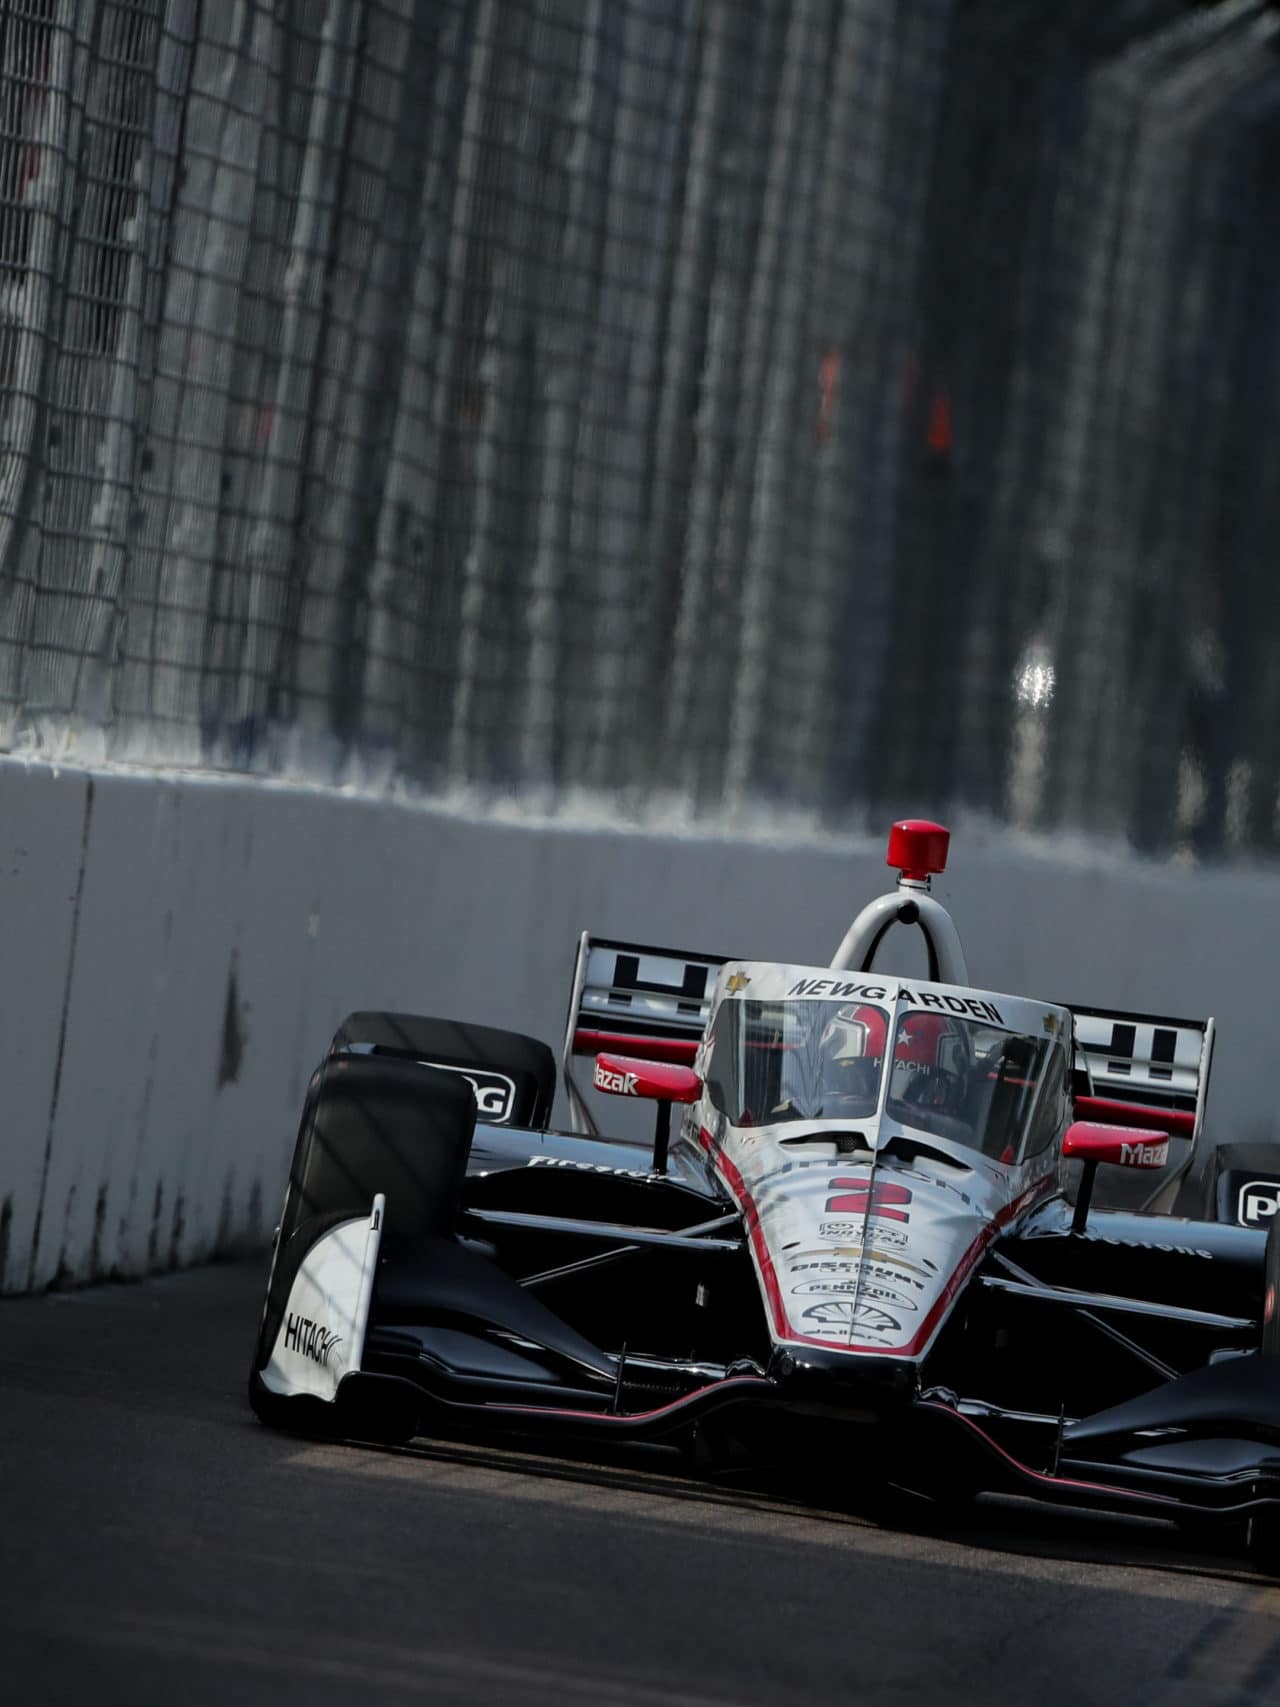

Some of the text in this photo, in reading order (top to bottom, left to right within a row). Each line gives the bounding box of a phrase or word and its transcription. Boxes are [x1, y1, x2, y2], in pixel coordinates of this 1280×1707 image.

[787, 978, 1005, 1025] NEWGARDEN
[594, 1063, 639, 1097] azak
[824, 1177, 913, 1224] 2
[790, 1262, 925, 1291] DISCOUNT
[809, 1283, 899, 1300] PENNZOIL
[284, 1312, 343, 1368] HITACHI
